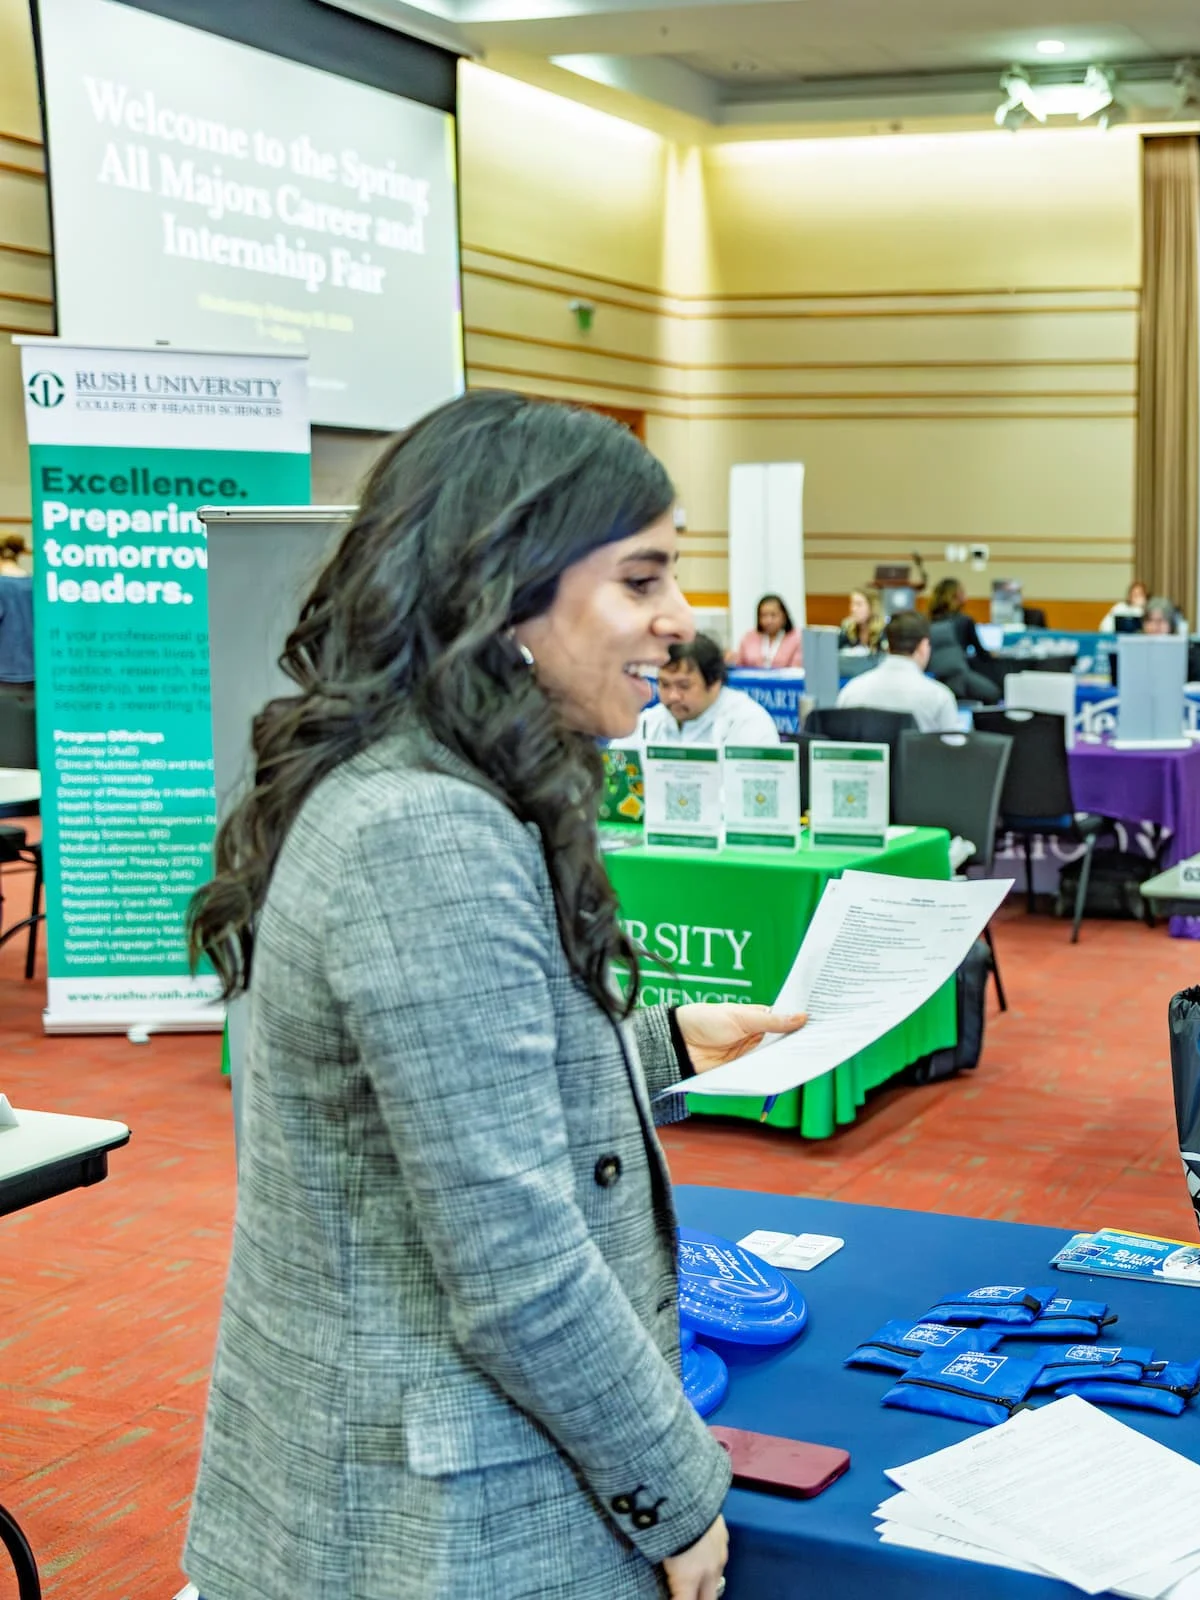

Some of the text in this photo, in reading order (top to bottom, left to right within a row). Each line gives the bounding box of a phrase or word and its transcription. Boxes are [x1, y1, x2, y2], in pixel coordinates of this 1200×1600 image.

[84, 76, 430, 217] Welcome to the Spring
[98, 142, 424, 254] All Majors Career and
[162, 213, 385, 294] Internship Fair
[76, 371, 137, 393] RUSH
[144, 375, 282, 398] UNIVERSITY
[76, 400, 283, 418] COLLEGE OF HEALTH SCIENCES
[41, 466, 248, 499] Excellence.
[46, 571, 193, 603] leaders.
[619, 920, 752, 970] RSITY
